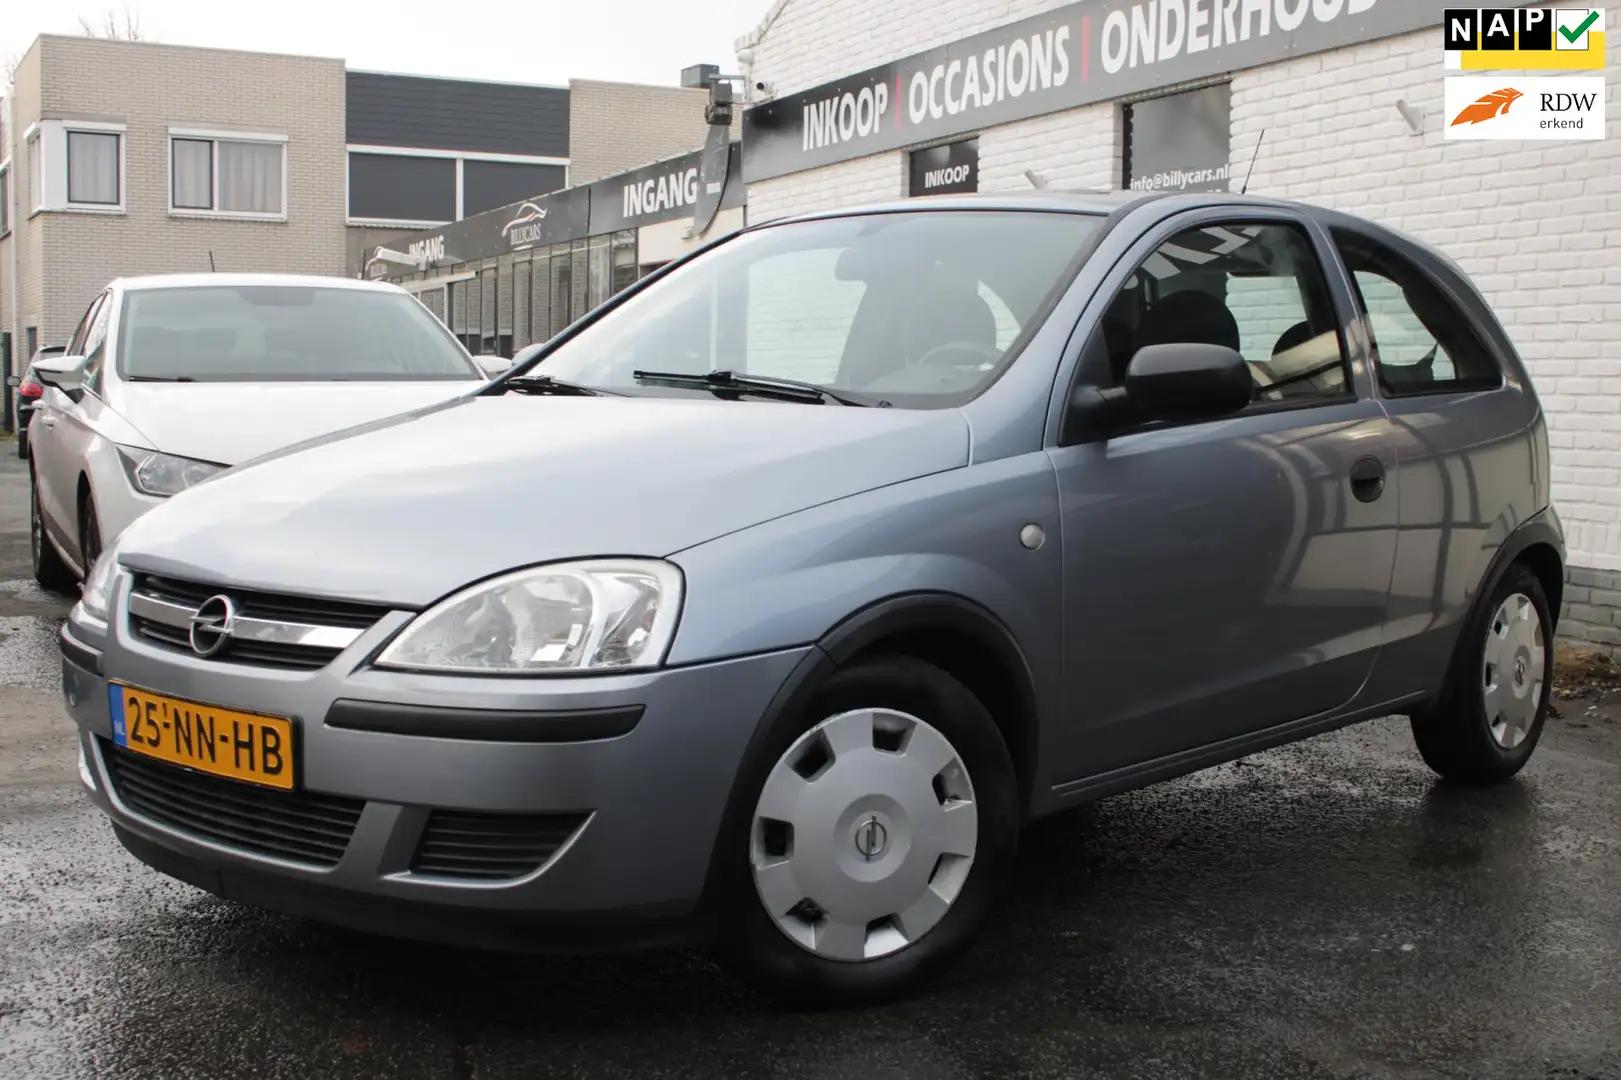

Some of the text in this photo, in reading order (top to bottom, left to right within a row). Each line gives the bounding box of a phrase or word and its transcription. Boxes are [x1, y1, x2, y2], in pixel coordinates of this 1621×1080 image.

[803, 0, 1376, 150] INKOOP OCCASIONS ONDERH
[623, 168, 698, 217] INGANG
[924, 164, 970, 188] INKOOP
[1130, 163, 1229, 189] info@billycars.nl
[128, 696, 283, 775] 25-NN-HB
